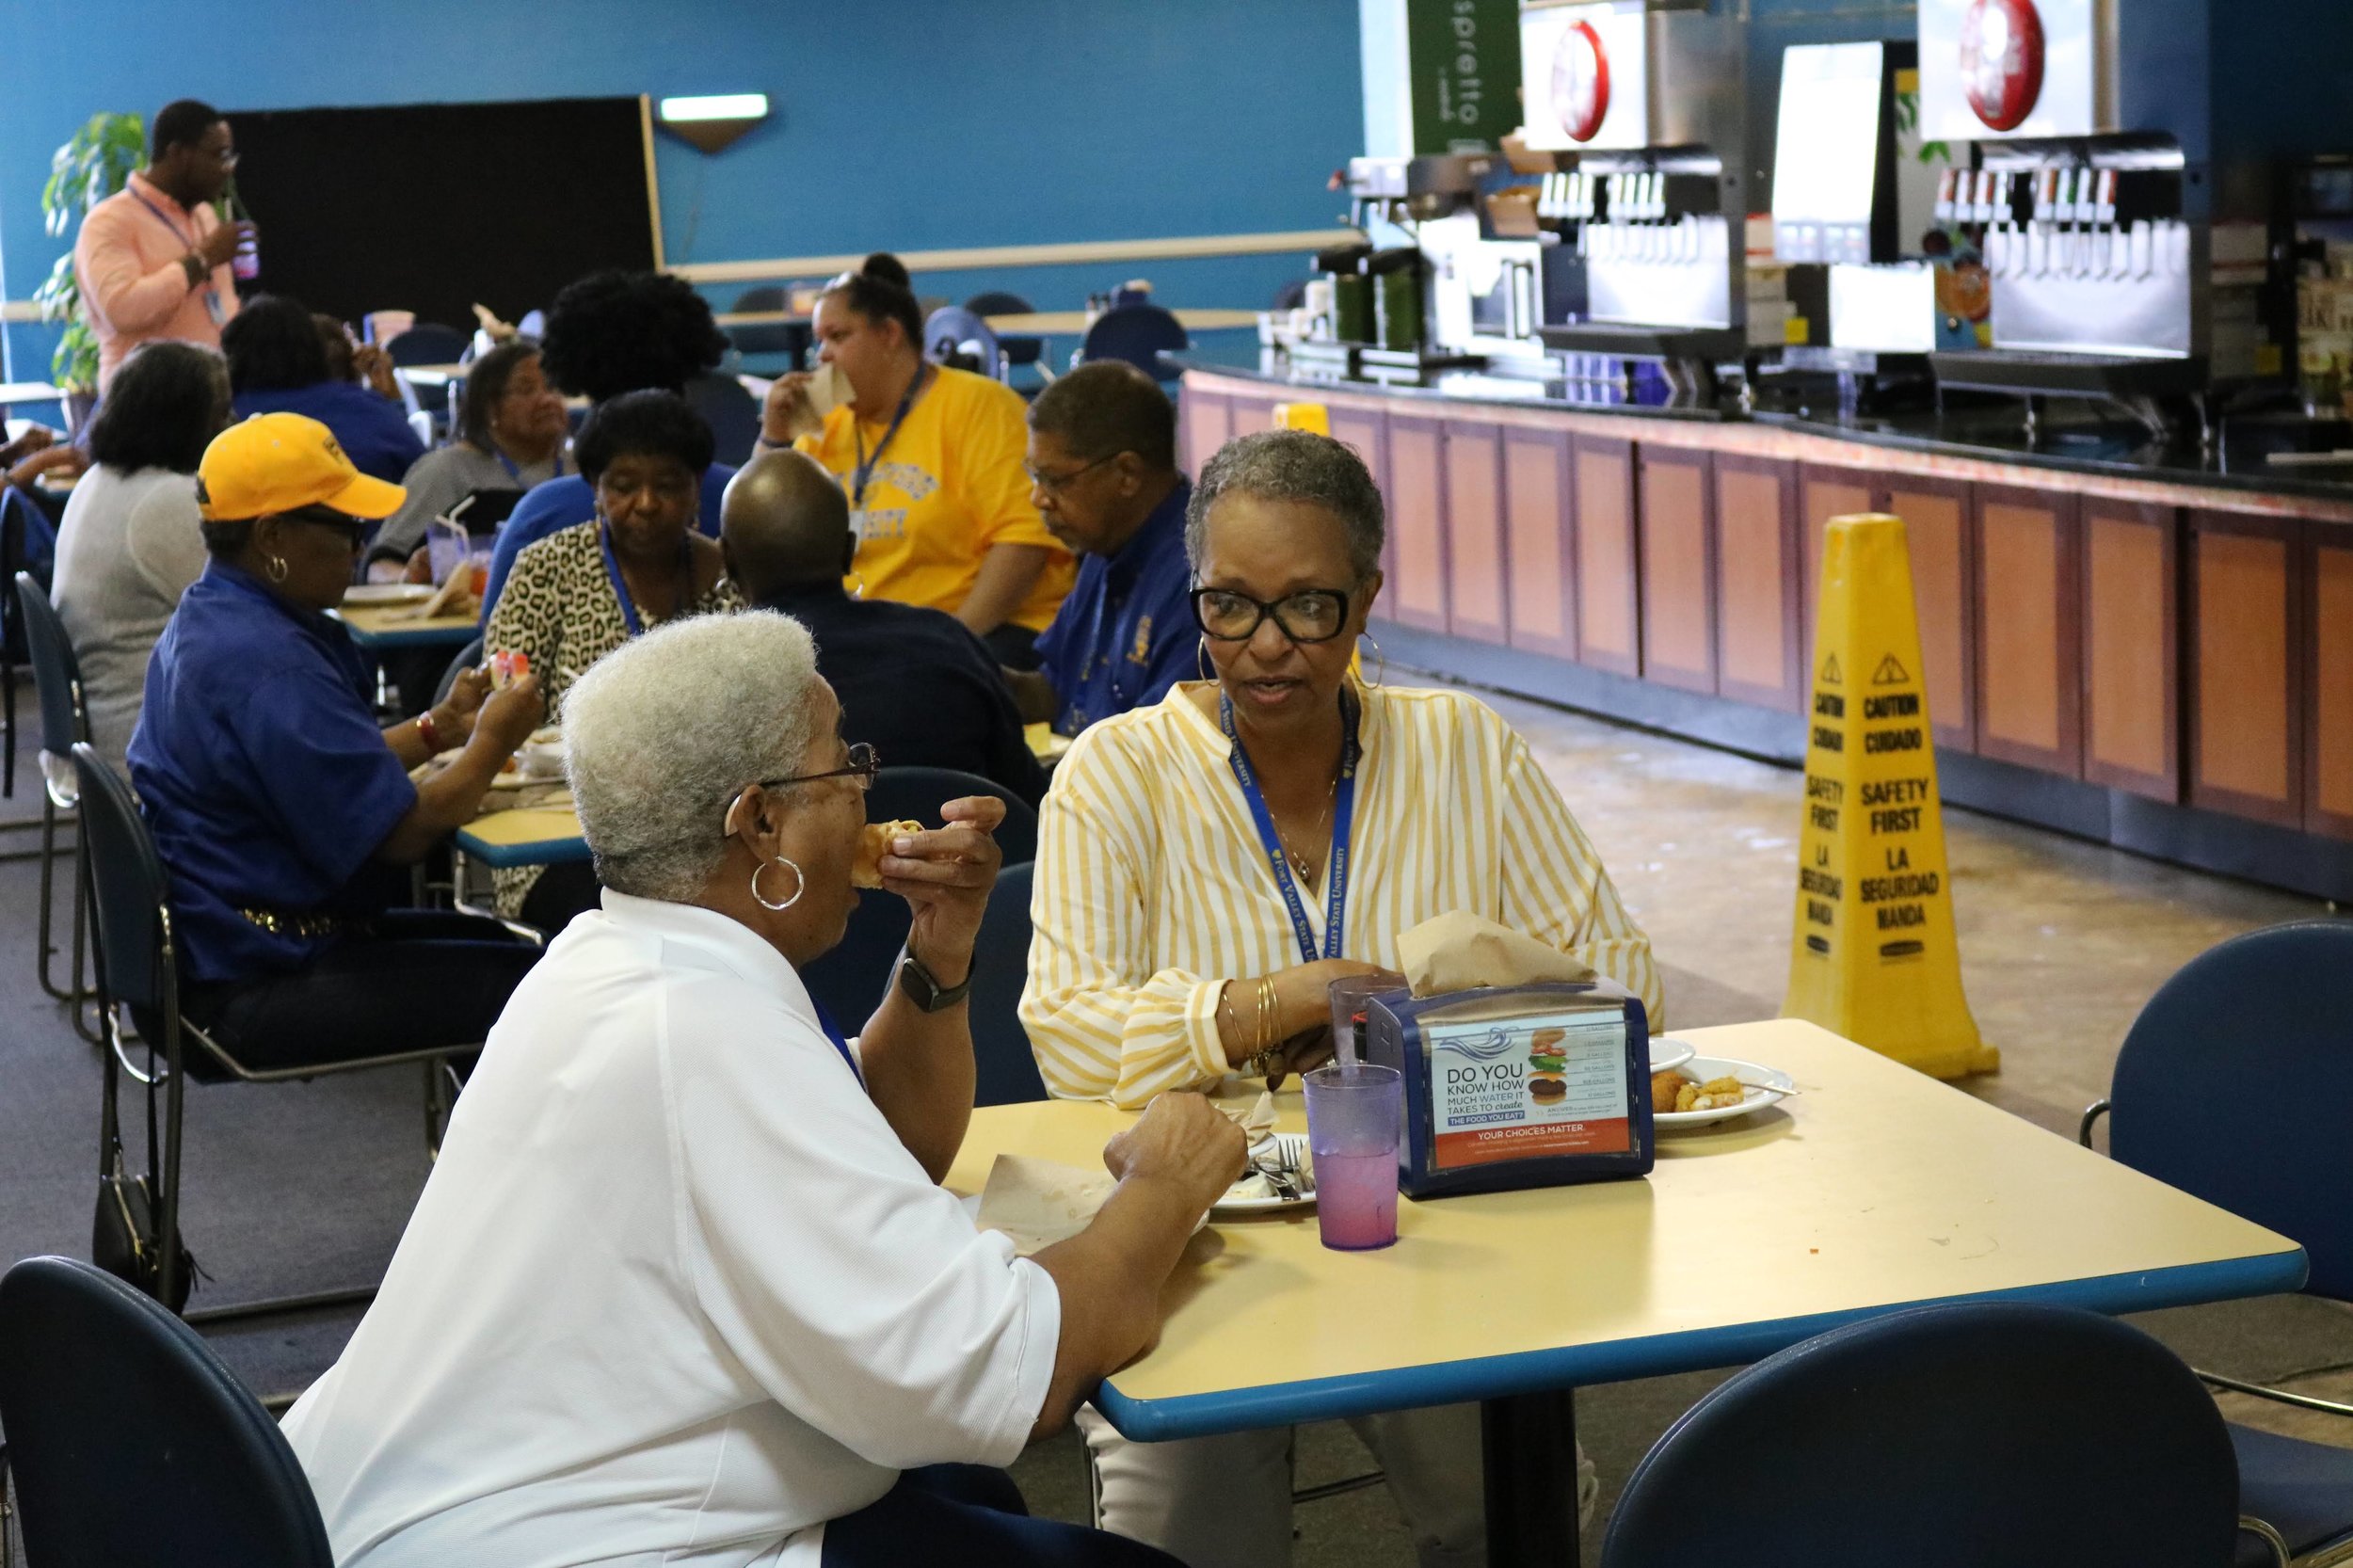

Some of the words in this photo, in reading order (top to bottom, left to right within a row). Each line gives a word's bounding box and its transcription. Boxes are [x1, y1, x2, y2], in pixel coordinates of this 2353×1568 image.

[1864, 694, 1919, 720] CAUTION
[1864, 728, 1923, 755] CUIDADO
[1861, 778, 1929, 807] SAFETY
[1869, 807, 1922, 836] FIRST
[1886, 847, 1910, 872] LA
[1332, 847, 1345, 899] UNIVERSITY
[1860, 872, 1939, 904] SEGURIDAD
[1275, 858, 1289, 883] FORT
[1285, 885, 1302, 920] VALLEY
[1299, 920, 1310, 946] STATE
[1331, 901, 1341, 927] STATE
[1876, 903, 1926, 931] MANDA
[1327, 928, 1338, 958] ALLEY
[1448, 1067, 1476, 1083] DO
[1481, 1063, 1523, 1080] YOU
[1448, 1082, 1488, 1096] KNOW
[1492, 1079, 1525, 1092] HOW
[1448, 1096, 1477, 1106] MUCH
[1480, 1092, 1513, 1103] WATER
[1515, 1092, 1525, 1100] IT
[1448, 1105, 1478, 1115] TAKES
[1480, 1103, 1493, 1112] TO
[1495, 1100, 1523, 1111] create
[1450, 1117, 1465, 1126] THE
[1465, 1115, 1487, 1124] FOOD
[1488, 1113, 1504, 1123] YOU
[1504, 1112, 1523, 1121] EAT?
[1478, 1130, 1504, 1141] YOUR
[1505, 1127, 1545, 1138] CHOICES
